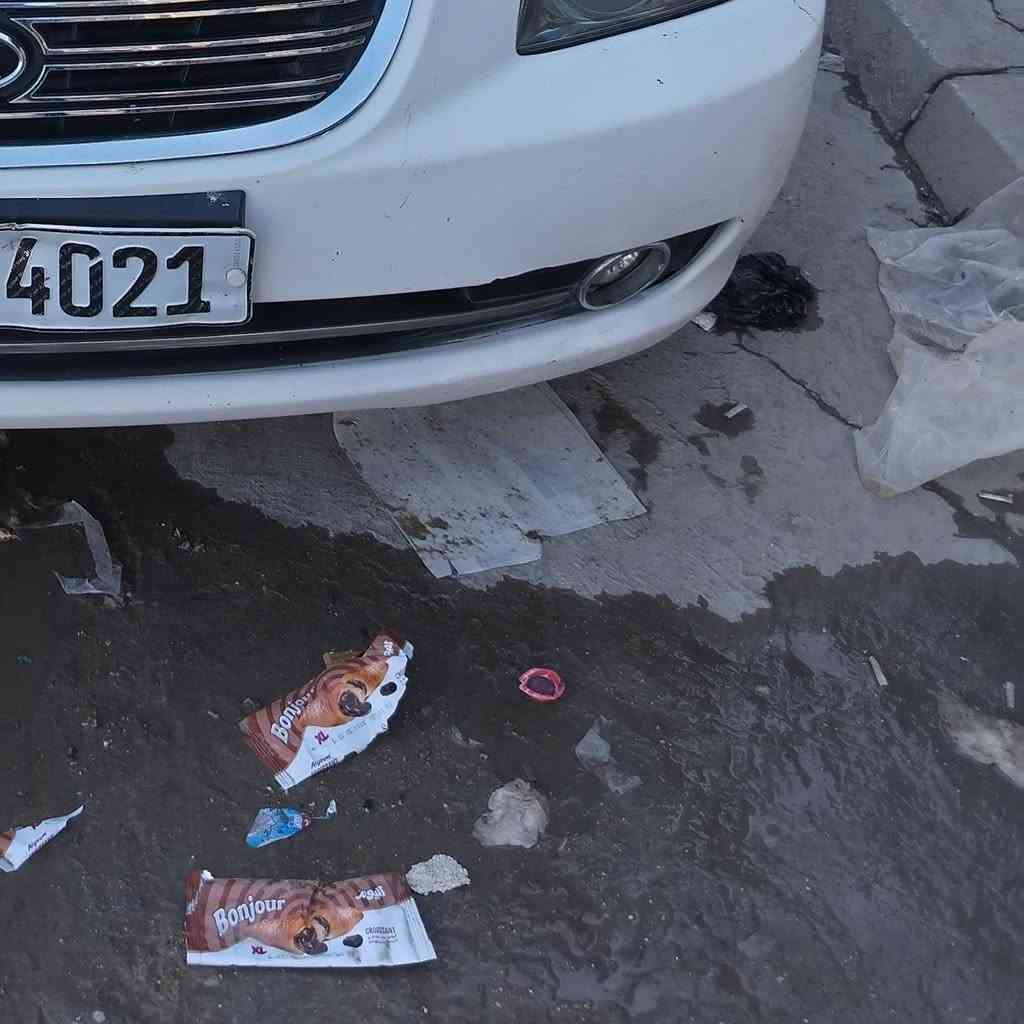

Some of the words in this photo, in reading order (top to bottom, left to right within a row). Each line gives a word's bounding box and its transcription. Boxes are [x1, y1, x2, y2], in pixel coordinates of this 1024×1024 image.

[314, 730, 330, 746] XL
[213, 895, 286, 937] Bonjour
[251, 944, 268, 955] XL
